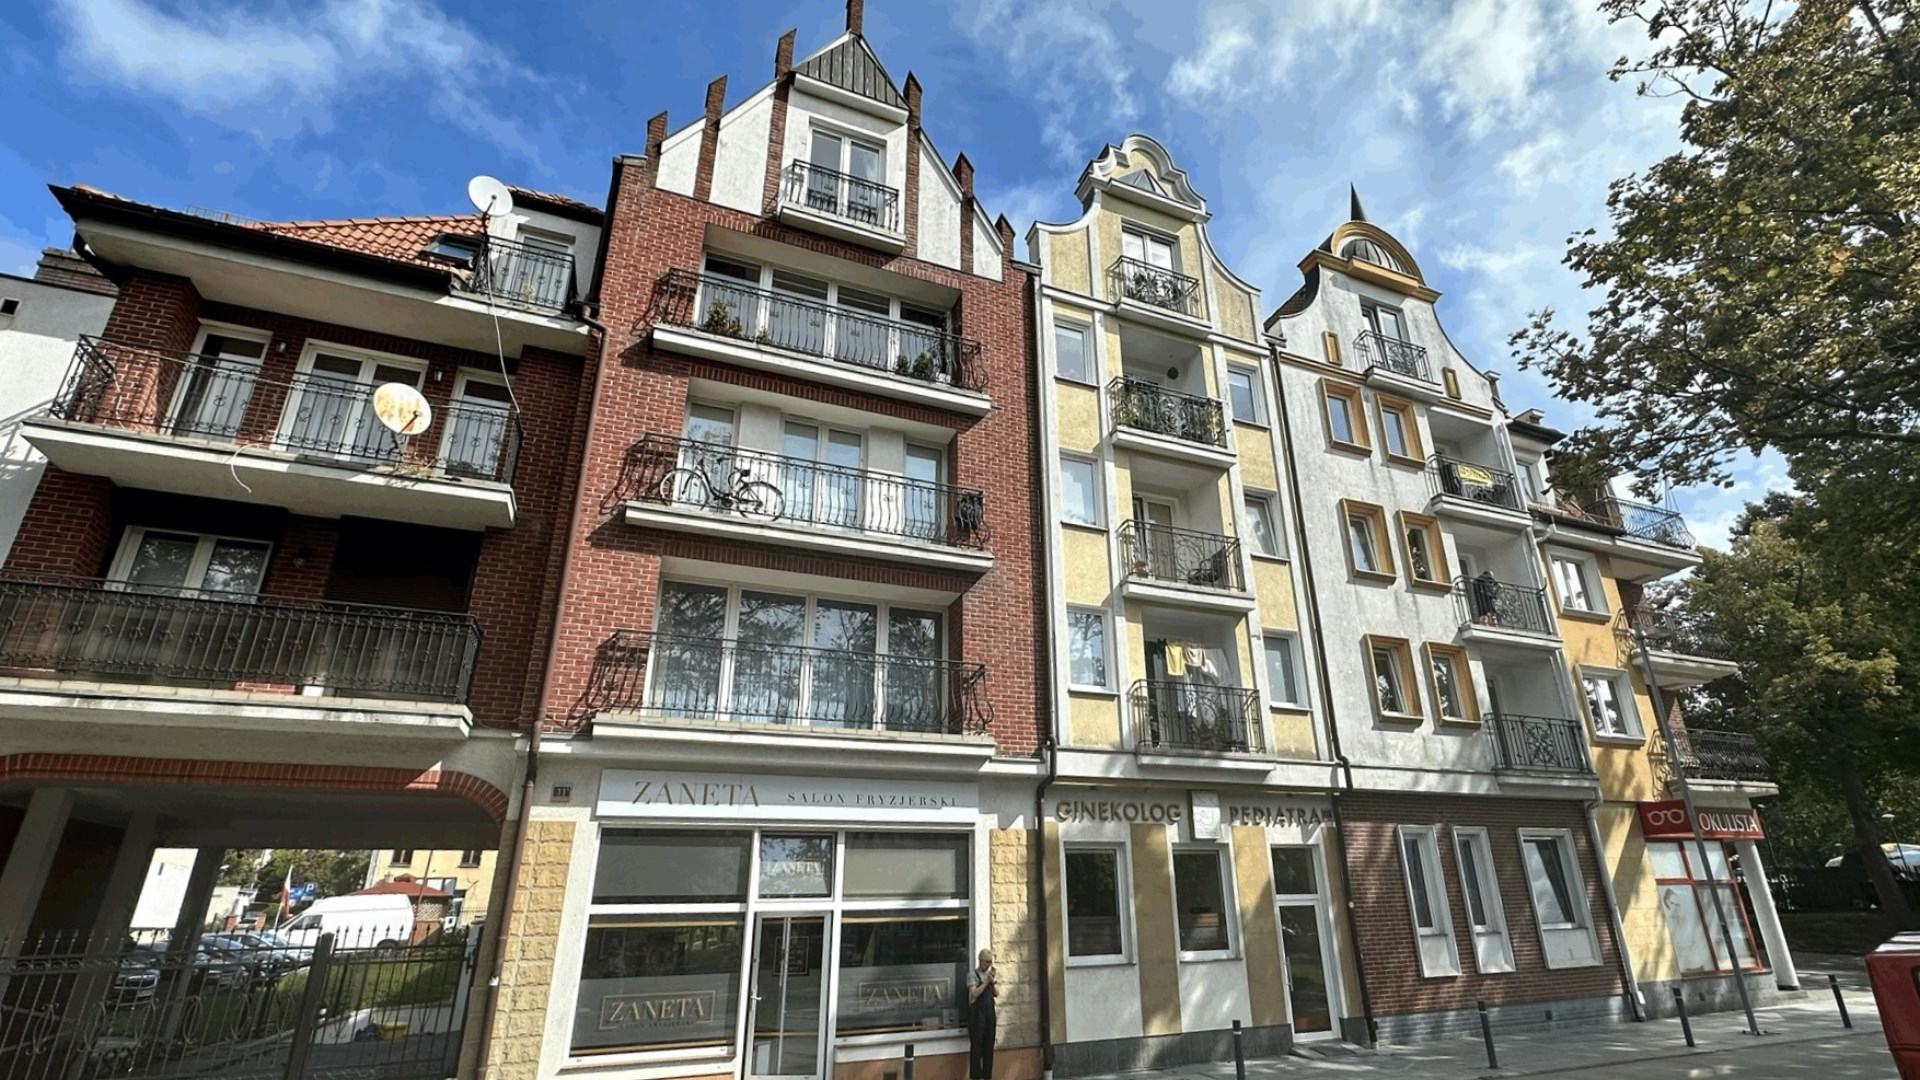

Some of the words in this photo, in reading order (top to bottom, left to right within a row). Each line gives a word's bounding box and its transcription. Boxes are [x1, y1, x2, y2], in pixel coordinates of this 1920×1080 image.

[632, 781, 759, 807] ZANETA
[787, 792, 845, 804] SALON
[856, 794, 957, 807] FRYZJERSKI
[1056, 801, 1181, 822] GINEKOLOG
[1229, 806, 1322, 825] PEDIATRA
[1698, 812, 1760, 832] OKULISTA
[306, 883, 315, 893] P
[609, 998, 705, 1021] ZANETA
